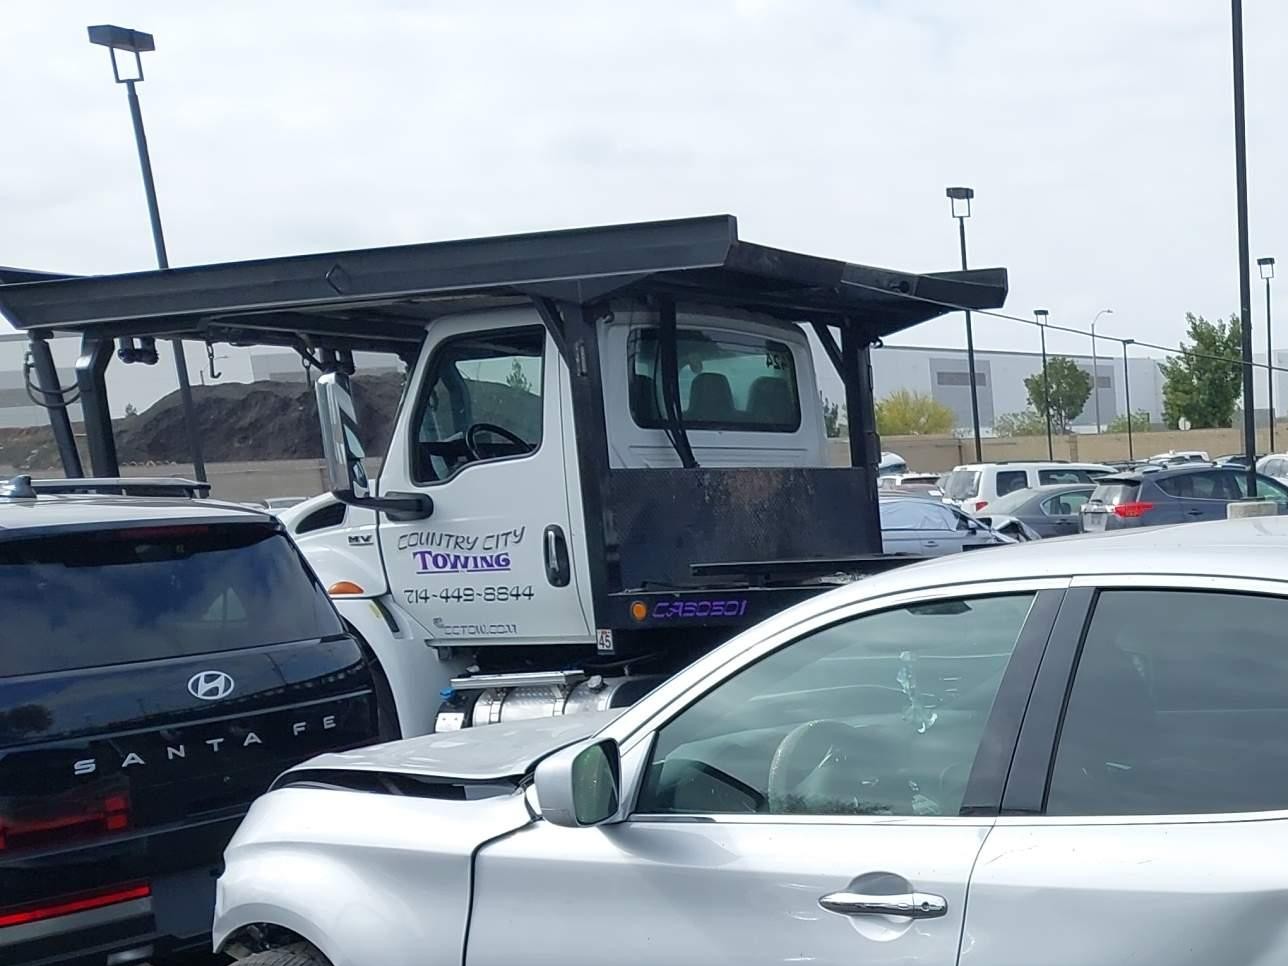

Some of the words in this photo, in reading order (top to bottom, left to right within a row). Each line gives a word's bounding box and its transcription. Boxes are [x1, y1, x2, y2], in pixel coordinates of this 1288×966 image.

[348, 535, 372, 543] MV
[397, 531, 479, 551] COUNTRY
[482, 525, 526, 550] CITY
[412, 550, 511, 570] TOWING
[403, 585, 535, 604] 714-449-8844
[598, 634, 611, 648] 45
[73, 732, 262, 776] SANTA
[293, 715, 336, 736] FE
